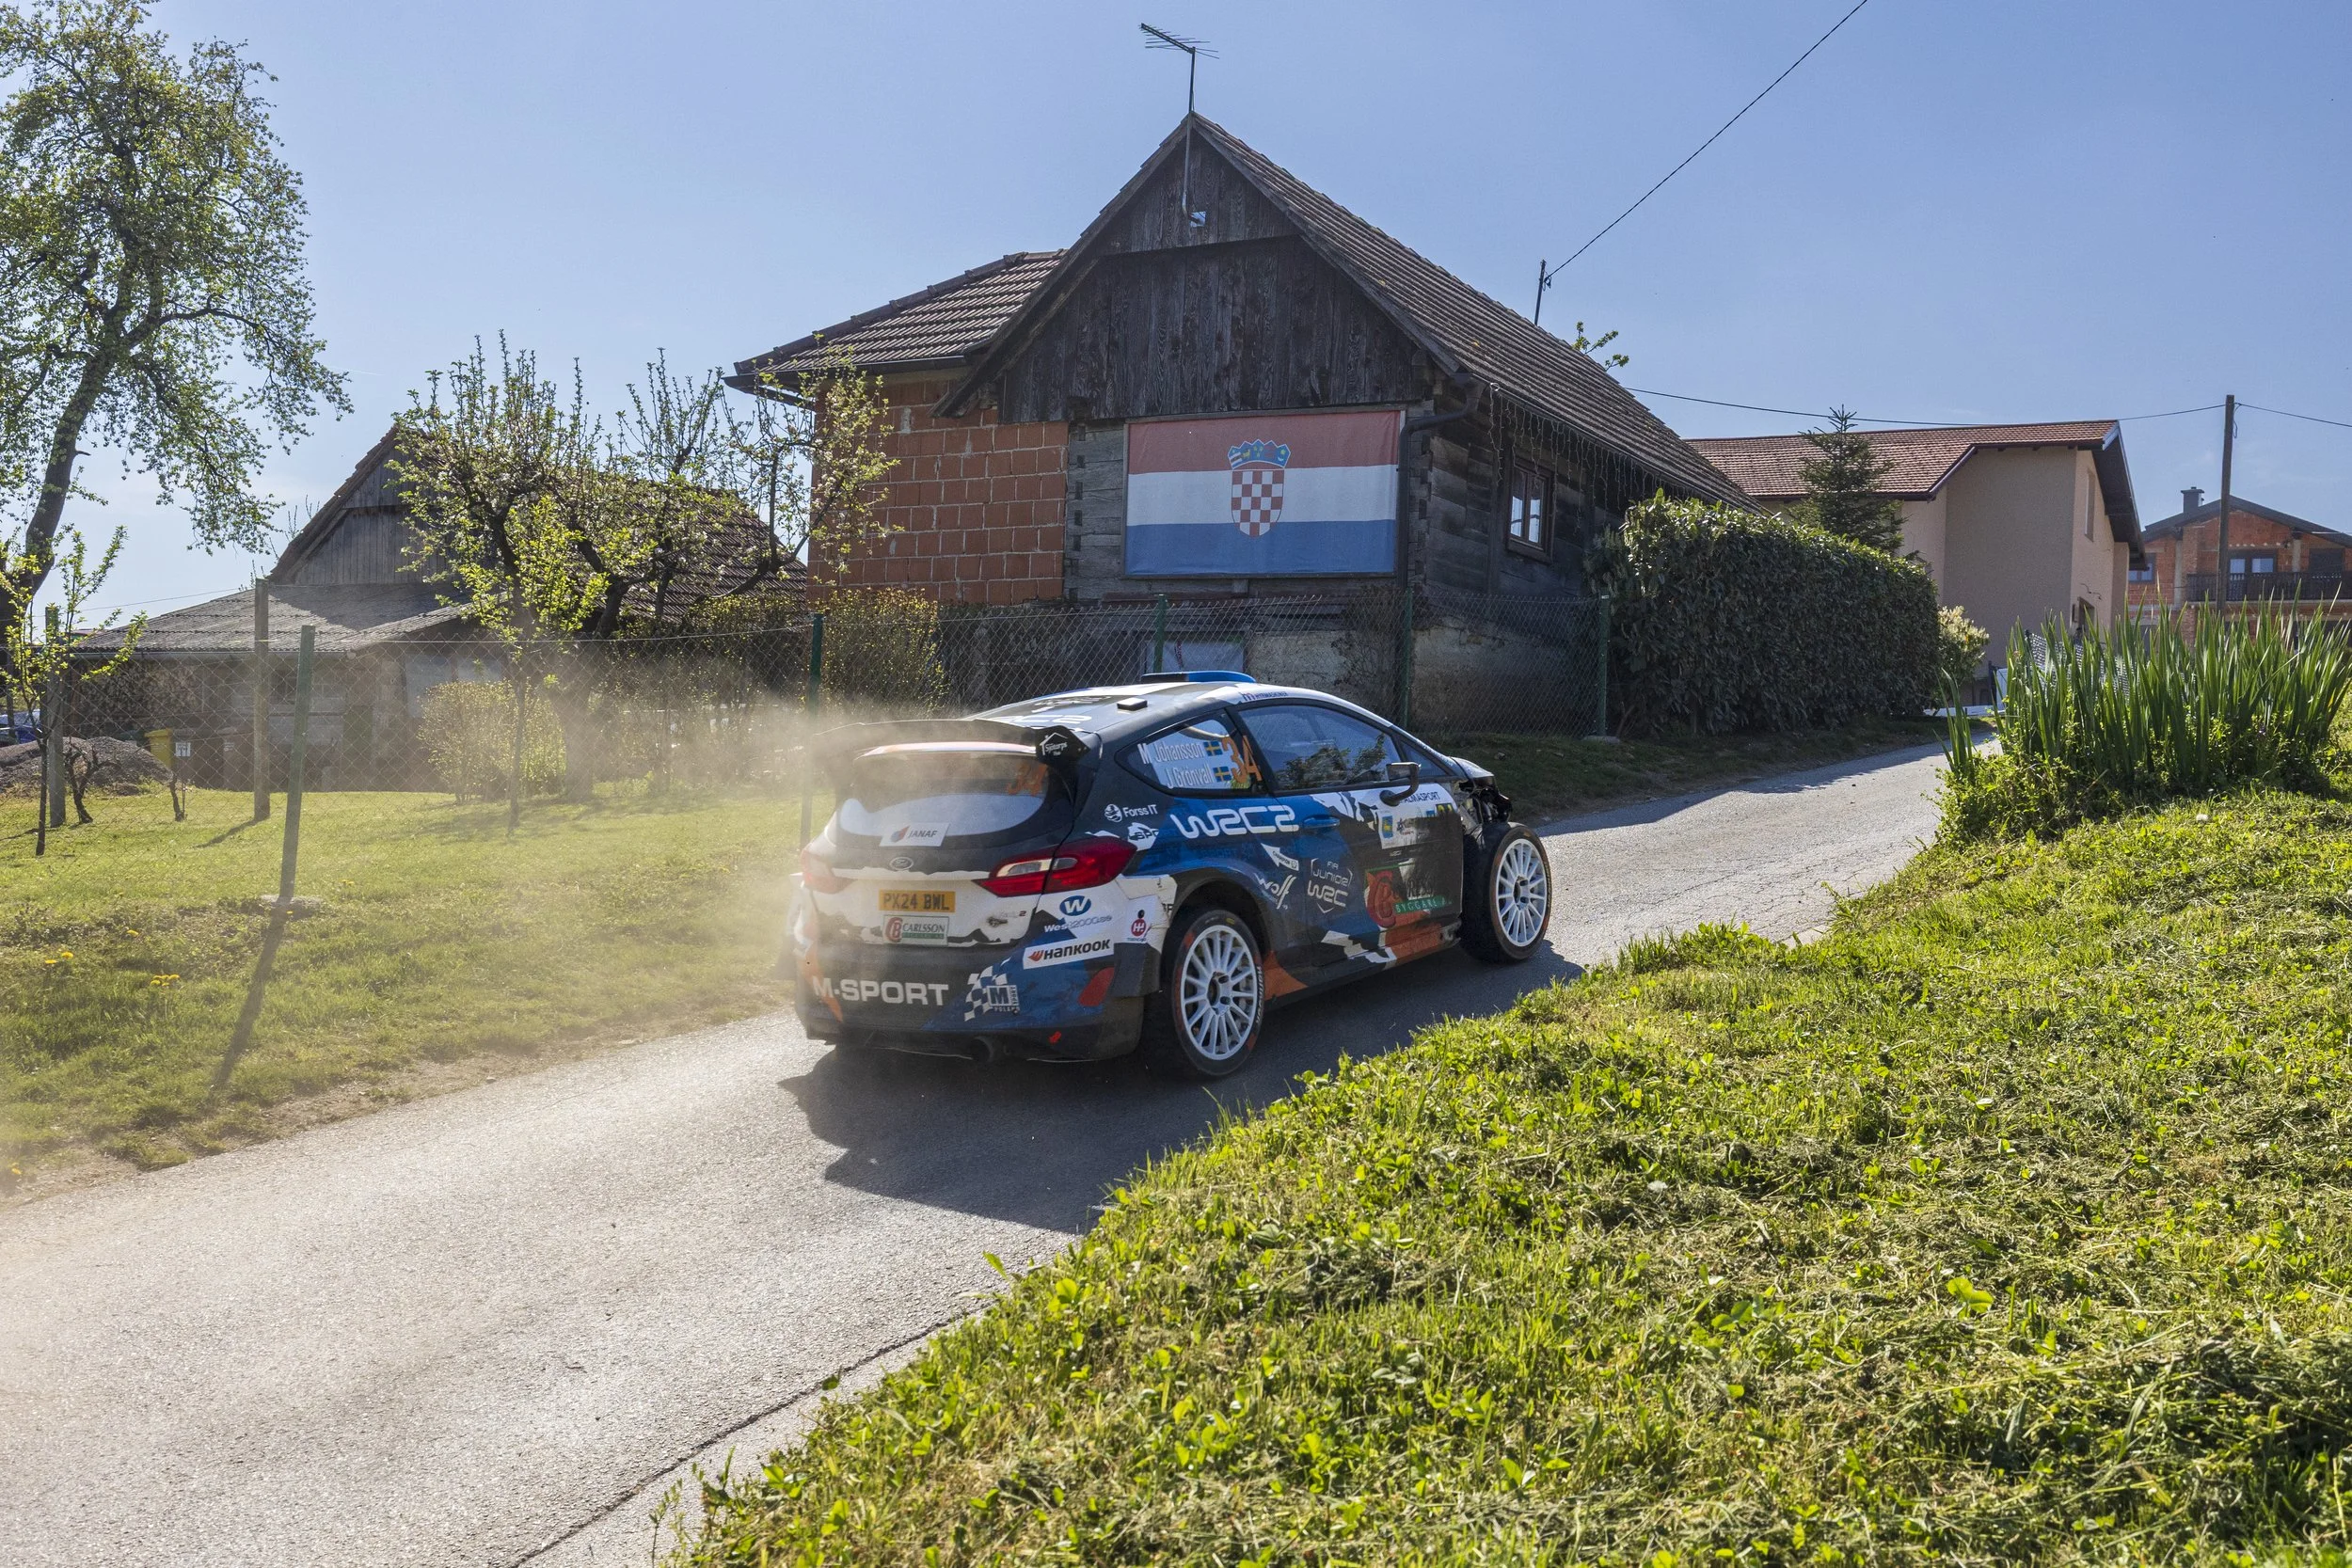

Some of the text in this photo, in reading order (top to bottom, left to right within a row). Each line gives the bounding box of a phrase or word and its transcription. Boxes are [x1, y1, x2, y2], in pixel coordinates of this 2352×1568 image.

[1136, 741, 1205, 764] M Johansson
[1164, 768, 1174, 789] J
[1170, 805, 1300, 838] WRC2
[909, 830, 937, 838] JANAF
[1327, 861, 1339, 870] FIA
[883, 893, 950, 911] PX24 BWL
[1307, 880, 1349, 908] WRC
[902, 923, 946, 933] CARLSSON
[812, 975, 949, 1006] M-SPORT
